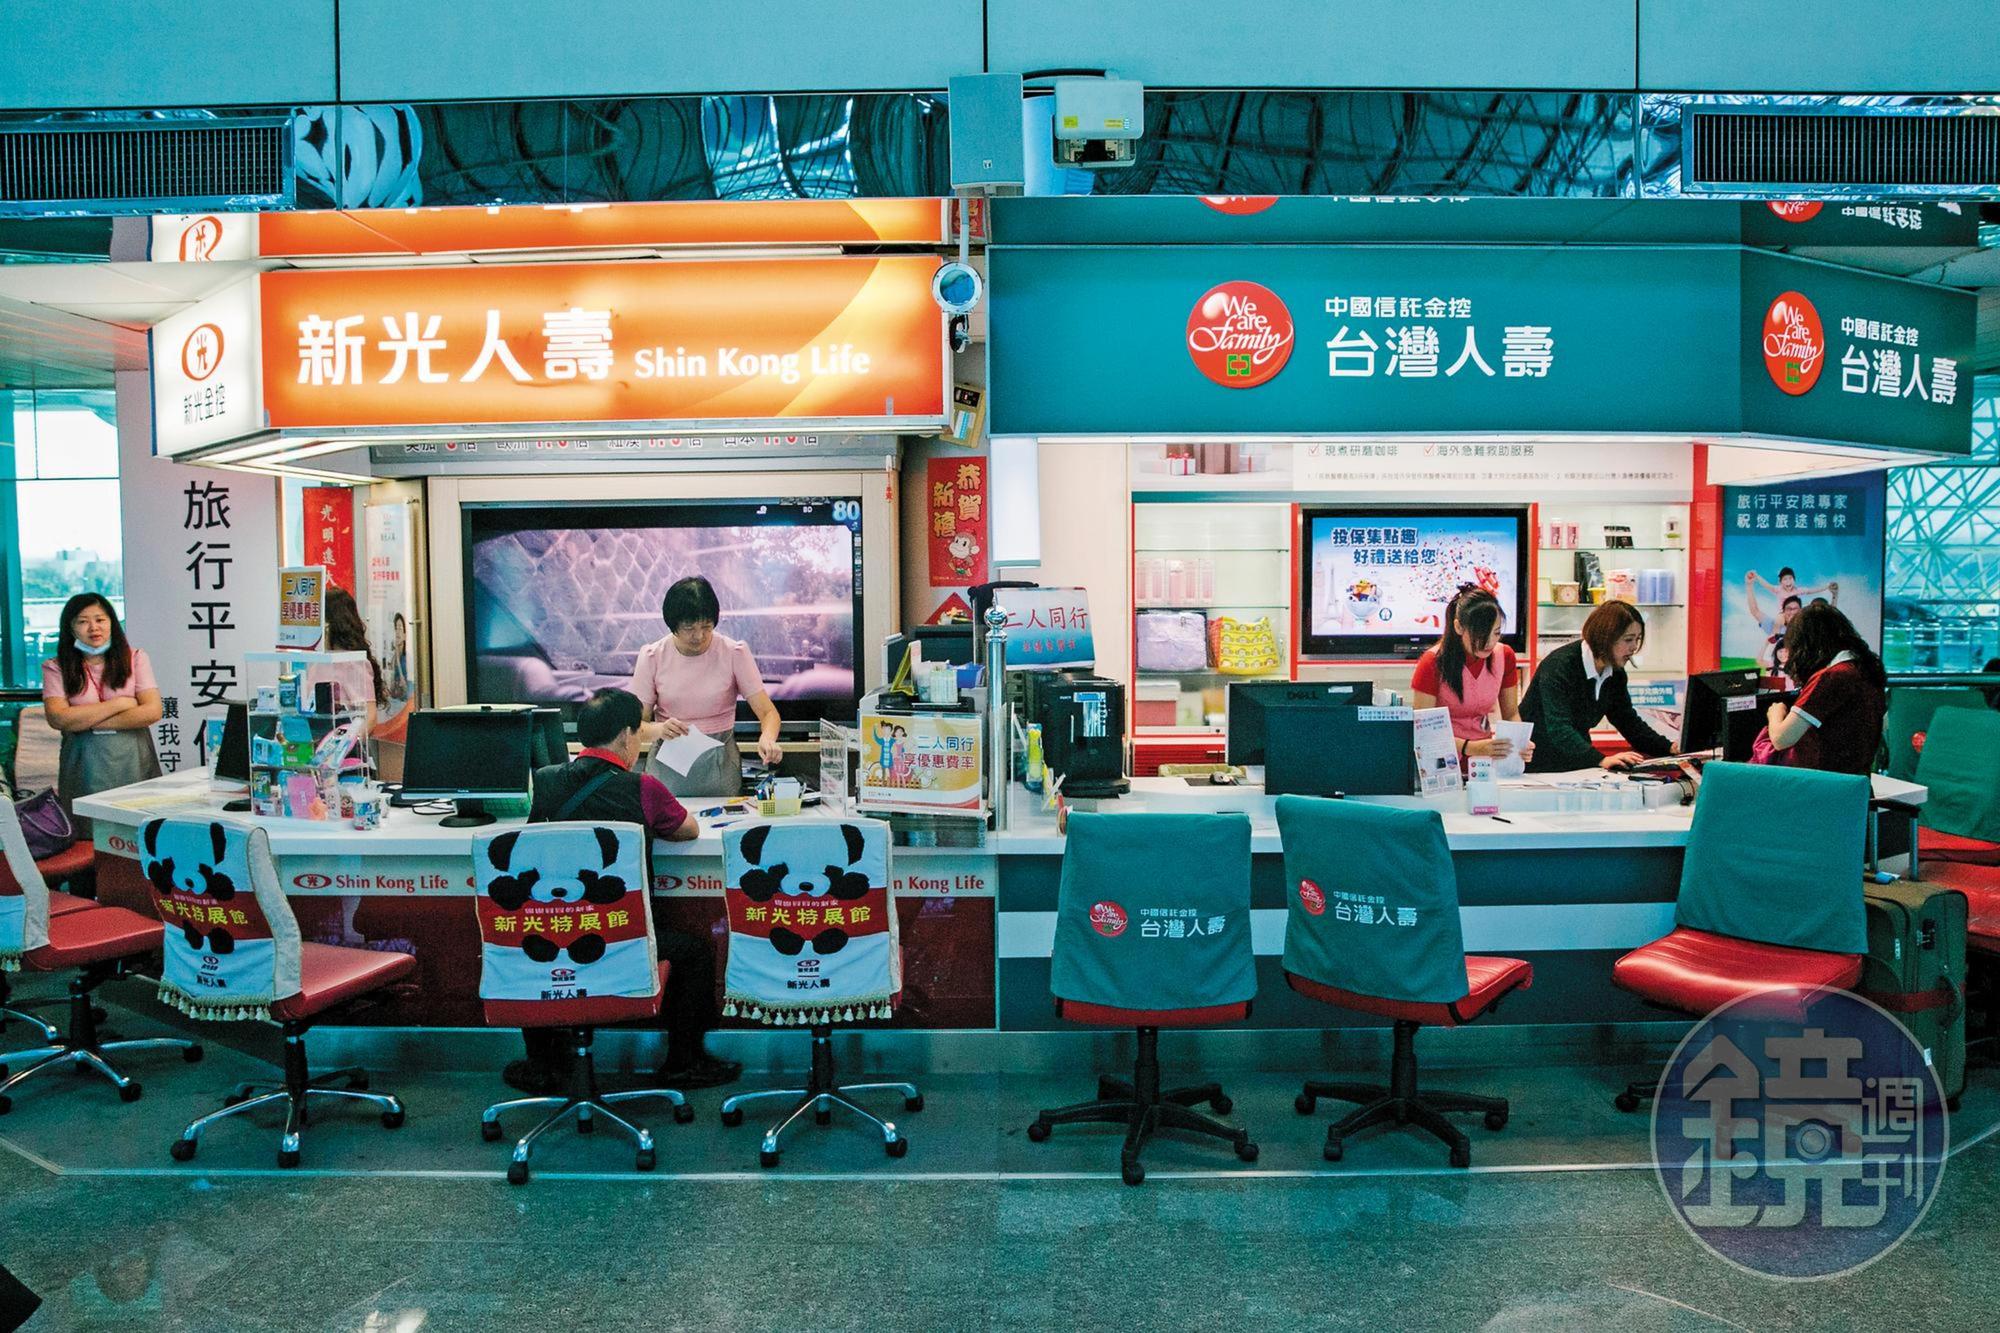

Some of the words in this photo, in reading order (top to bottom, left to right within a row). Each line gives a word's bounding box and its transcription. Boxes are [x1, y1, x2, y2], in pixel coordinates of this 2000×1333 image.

[1222, 295, 1258, 317] We
[1325, 296, 1471, 318] 中國信託金控
[1782, 304, 1804, 325] We
[1236, 314, 1268, 332] are
[1790, 325, 1810, 340] are
[1841, 316, 1919, 347] 中國信託金控
[297, 307, 614, 386] 新光人壽
[1189, 314, 1293, 366] Family
[1763, 324, 1824, 374] Family
[1326, 325, 1554, 378] 台灣人壽
[634, 346, 707, 379] Shin
[718, 347, 801, 384] Kong
[811, 343, 871, 376] Life
[1841, 344, 1958, 405] 台灣人壽
[184, 384, 226, 425] 新光金控
[1325, 444, 1399, 457] 現煮研磨咖啡
[1437, 444, 1535, 457] 海外急難救助服務
[957, 464, 982, 521] 恭賀
[1737, 494, 1848, 510] 旅行平安險專家
[832, 500, 861, 521] 80
[933, 481, 956, 537] 新禧
[1737, 513, 1847, 529] 祝您旅途愉快
[1332, 528, 1420, 546] 投保集點趣
[1353, 549, 1438, 566] 好禮送給您
[286, 577, 315, 596] 二人同行
[1003, 607, 1088, 630] 二人同行
[918, 736, 975, 752] 二人同行
[903, 753, 975, 769] 享優惠費率
[336, 875, 370, 889] Shin
[376, 875, 415, 893] Kong
[420, 874, 449, 889] Life
[687, 876, 722, 890] Shin
[908, 876, 950, 893] Kong
[955, 875, 985, 889] Life
[494, 910, 629, 933] 新光特展館
[746, 906, 871, 926] 新光特展館
[1140, 908, 1198, 917] 中國信託金控
[1334, 902, 1418, 927] 台灣人壽
[1140, 915, 1226, 938] 台灣人壽
